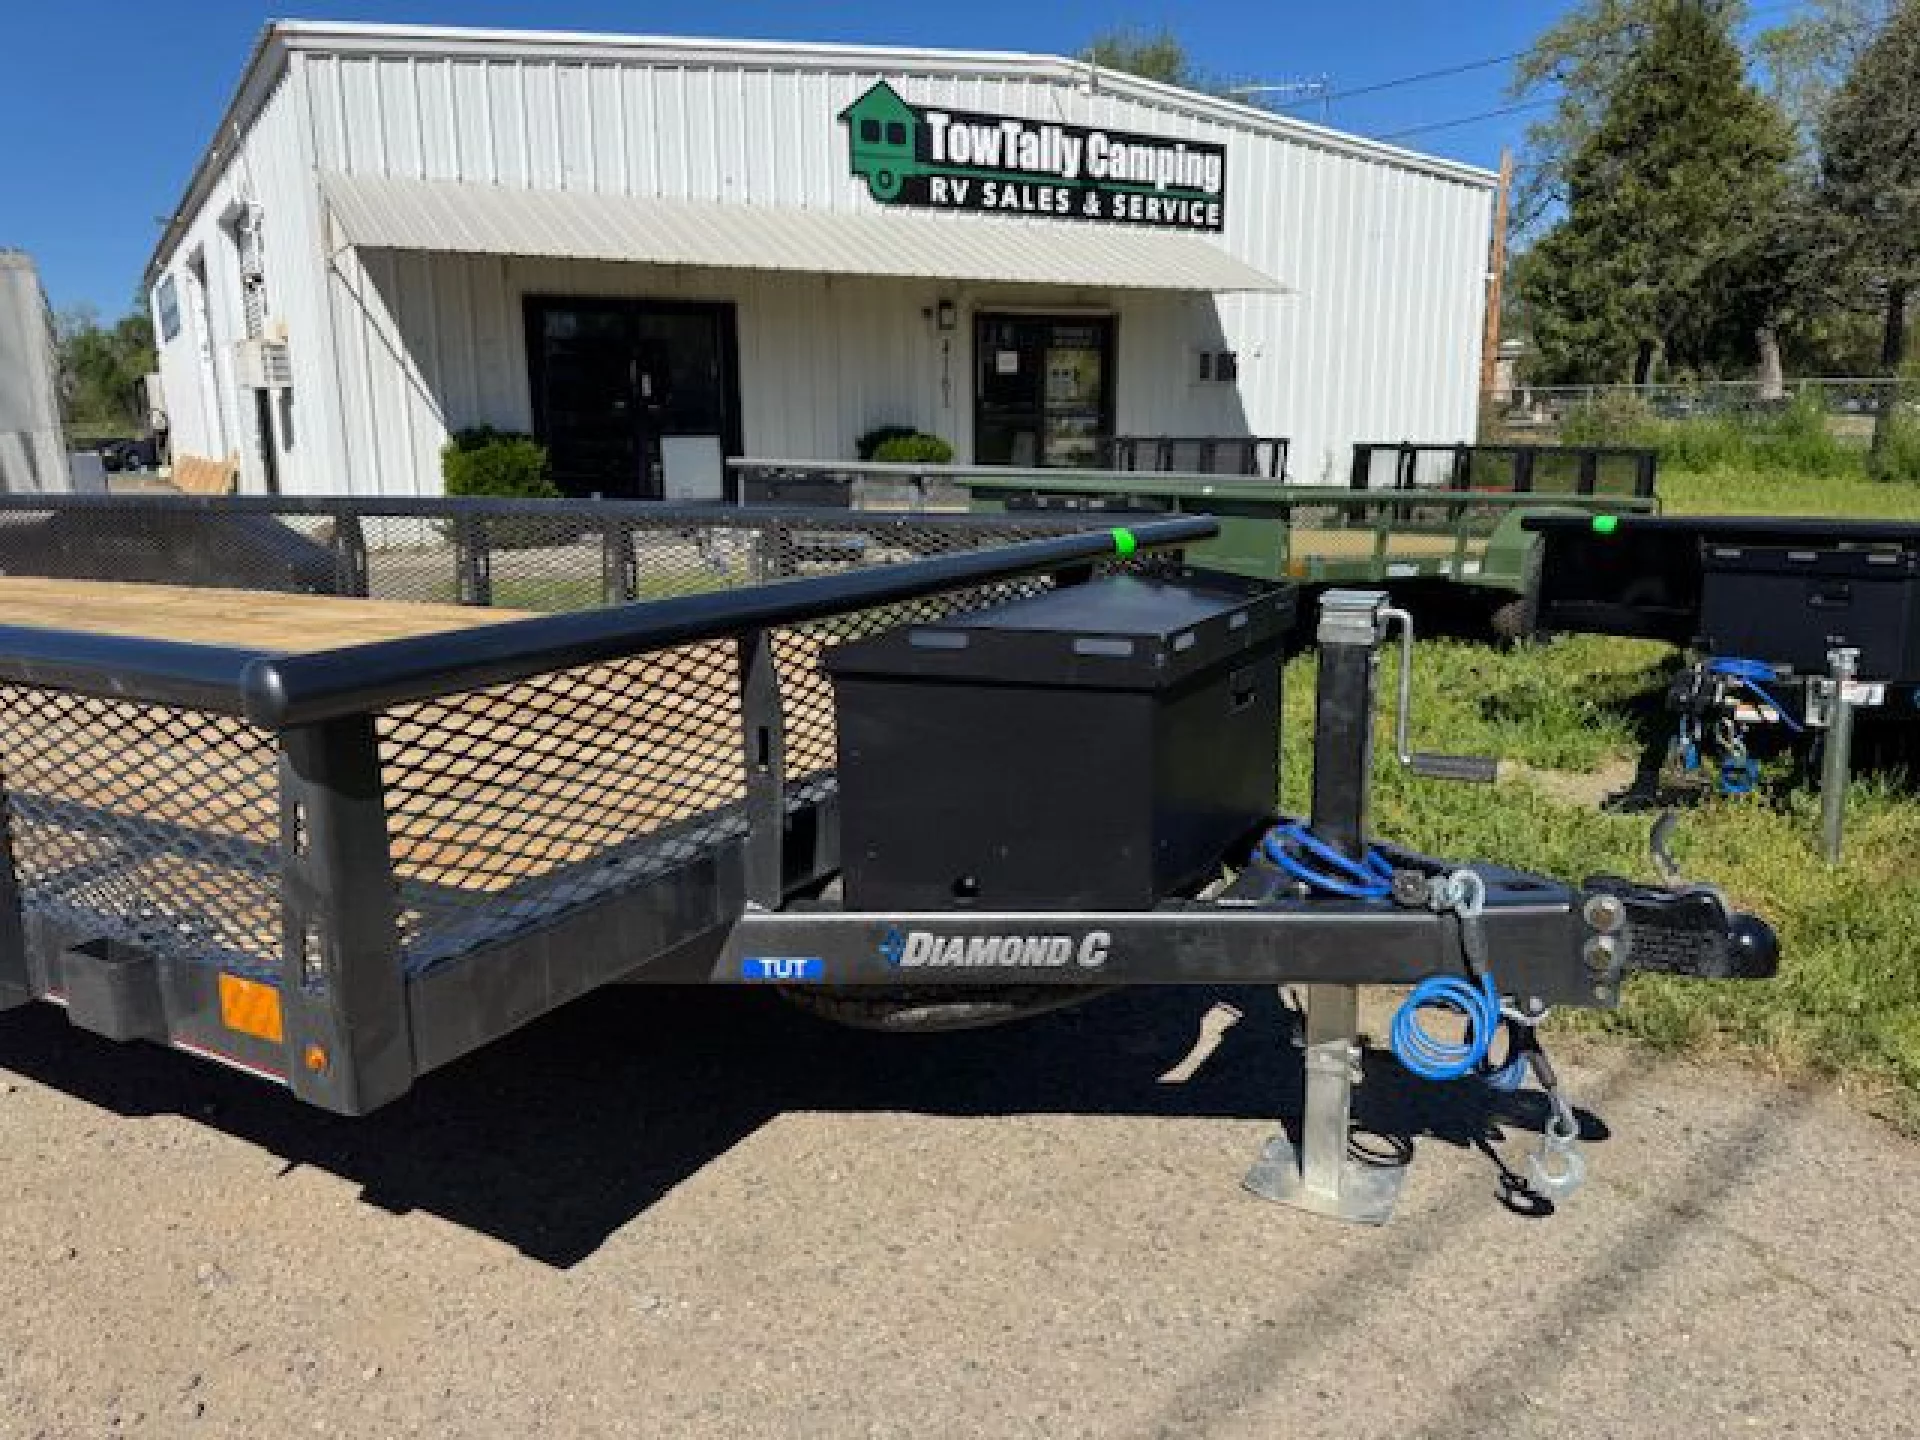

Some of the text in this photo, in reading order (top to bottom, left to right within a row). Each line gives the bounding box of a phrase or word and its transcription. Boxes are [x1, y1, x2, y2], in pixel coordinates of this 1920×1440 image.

[926, 112, 1223, 194] TowTally Camping
[931, 177, 1220, 226] RV SALES & SERVICE
[758, 957, 808, 979] TUT
[901, 930, 1111, 967] DIAMOND C
